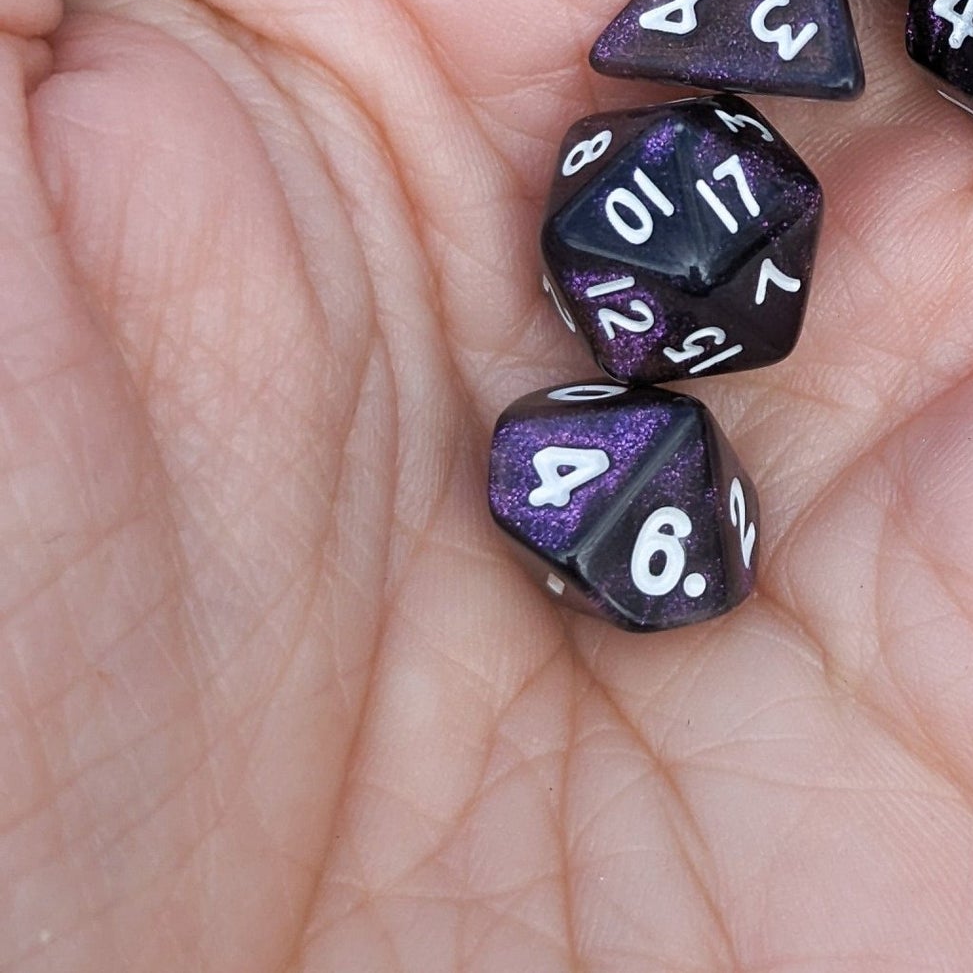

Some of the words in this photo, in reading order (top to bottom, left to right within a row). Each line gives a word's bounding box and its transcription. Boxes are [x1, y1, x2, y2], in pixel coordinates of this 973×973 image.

[562, 130, 613, 176] 8
[714, 109, 774, 142] 3
[605, 167, 675, 245] 10
[695, 154, 760, 234] 17
[585, 276, 655, 340] 12
[755, 258, 801, 305] 7
[663, 326, 743, 374] 15
[528, 446, 610, 507] 4
[729, 477, 756, 569] 2
